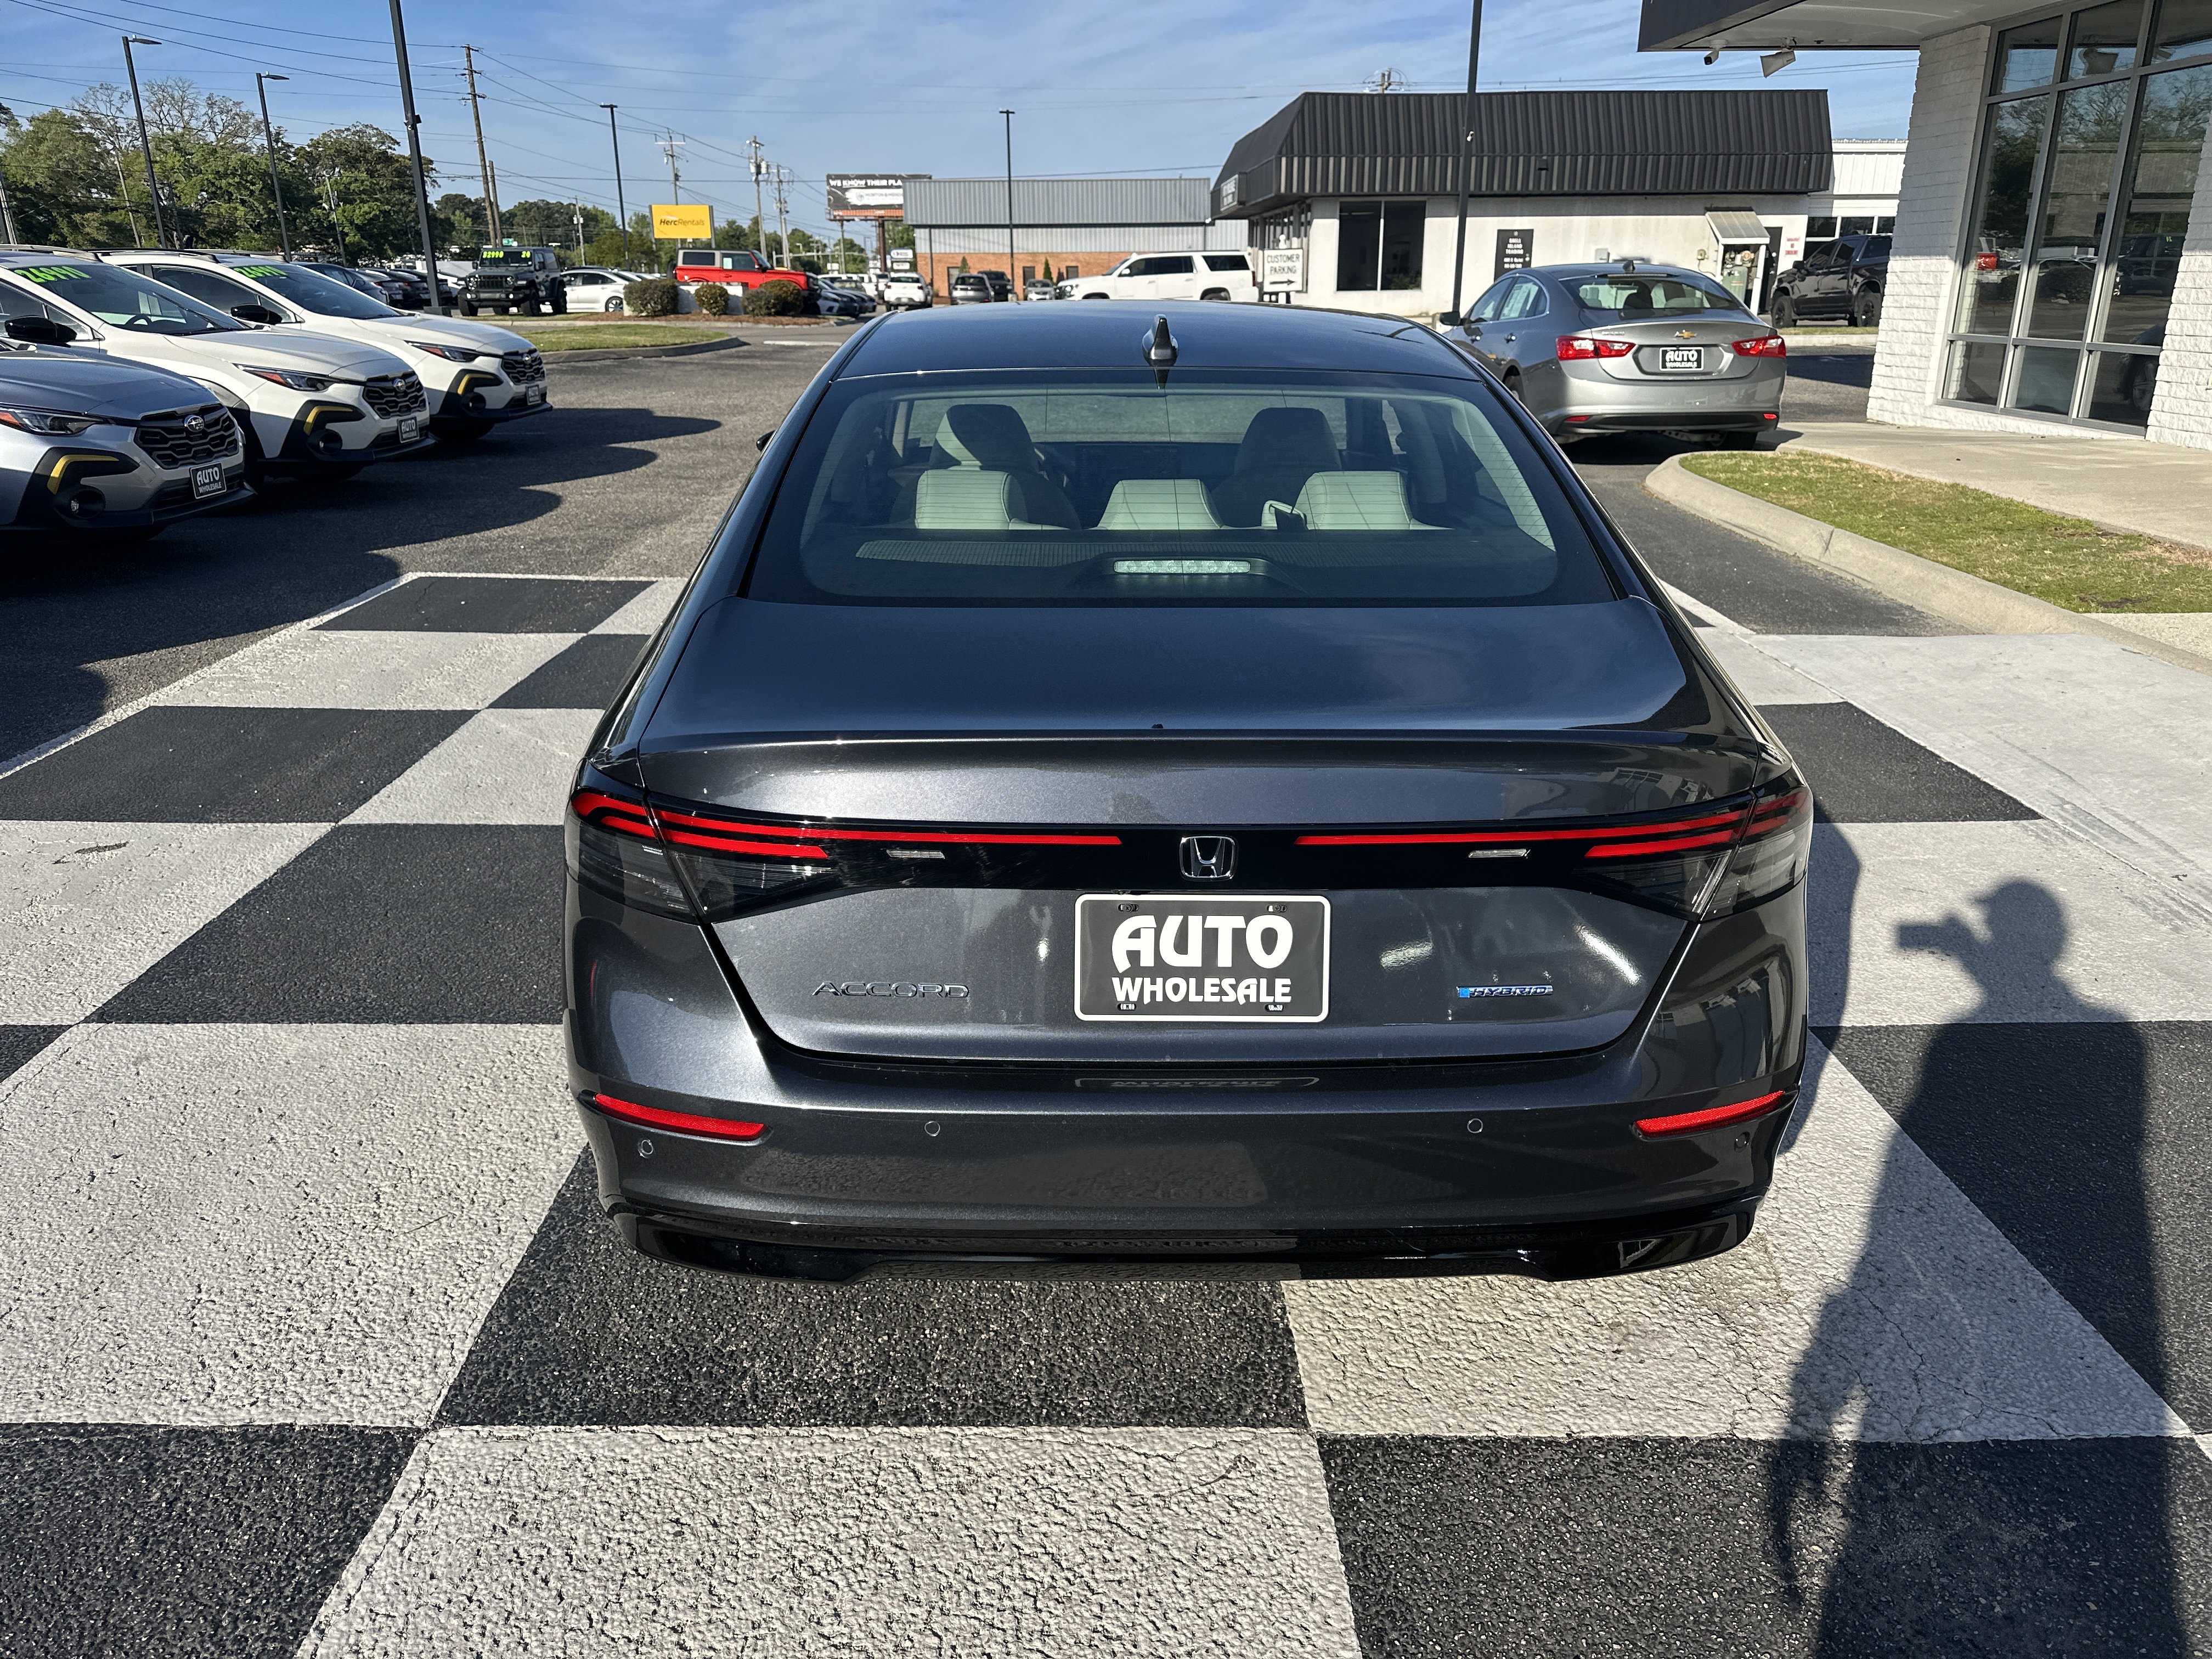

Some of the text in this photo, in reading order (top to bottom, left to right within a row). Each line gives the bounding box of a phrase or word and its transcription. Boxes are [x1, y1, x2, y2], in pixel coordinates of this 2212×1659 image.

[1266, 253, 1300, 263] CUSTOMER
[14, 266, 92, 283] 26990
[1269, 266, 1297, 274] PARKING
[1665, 350, 1698, 362] AUTO
[401, 419, 416, 433] AUTO
[196, 467, 219, 486] AUTO
[1111, 915, 1293, 974] AUTO
[811, 981, 969, 997] ACCORD
[1111, 977, 1292, 1005] WHOLESALE
[1469, 986, 1548, 997] HYBRID
